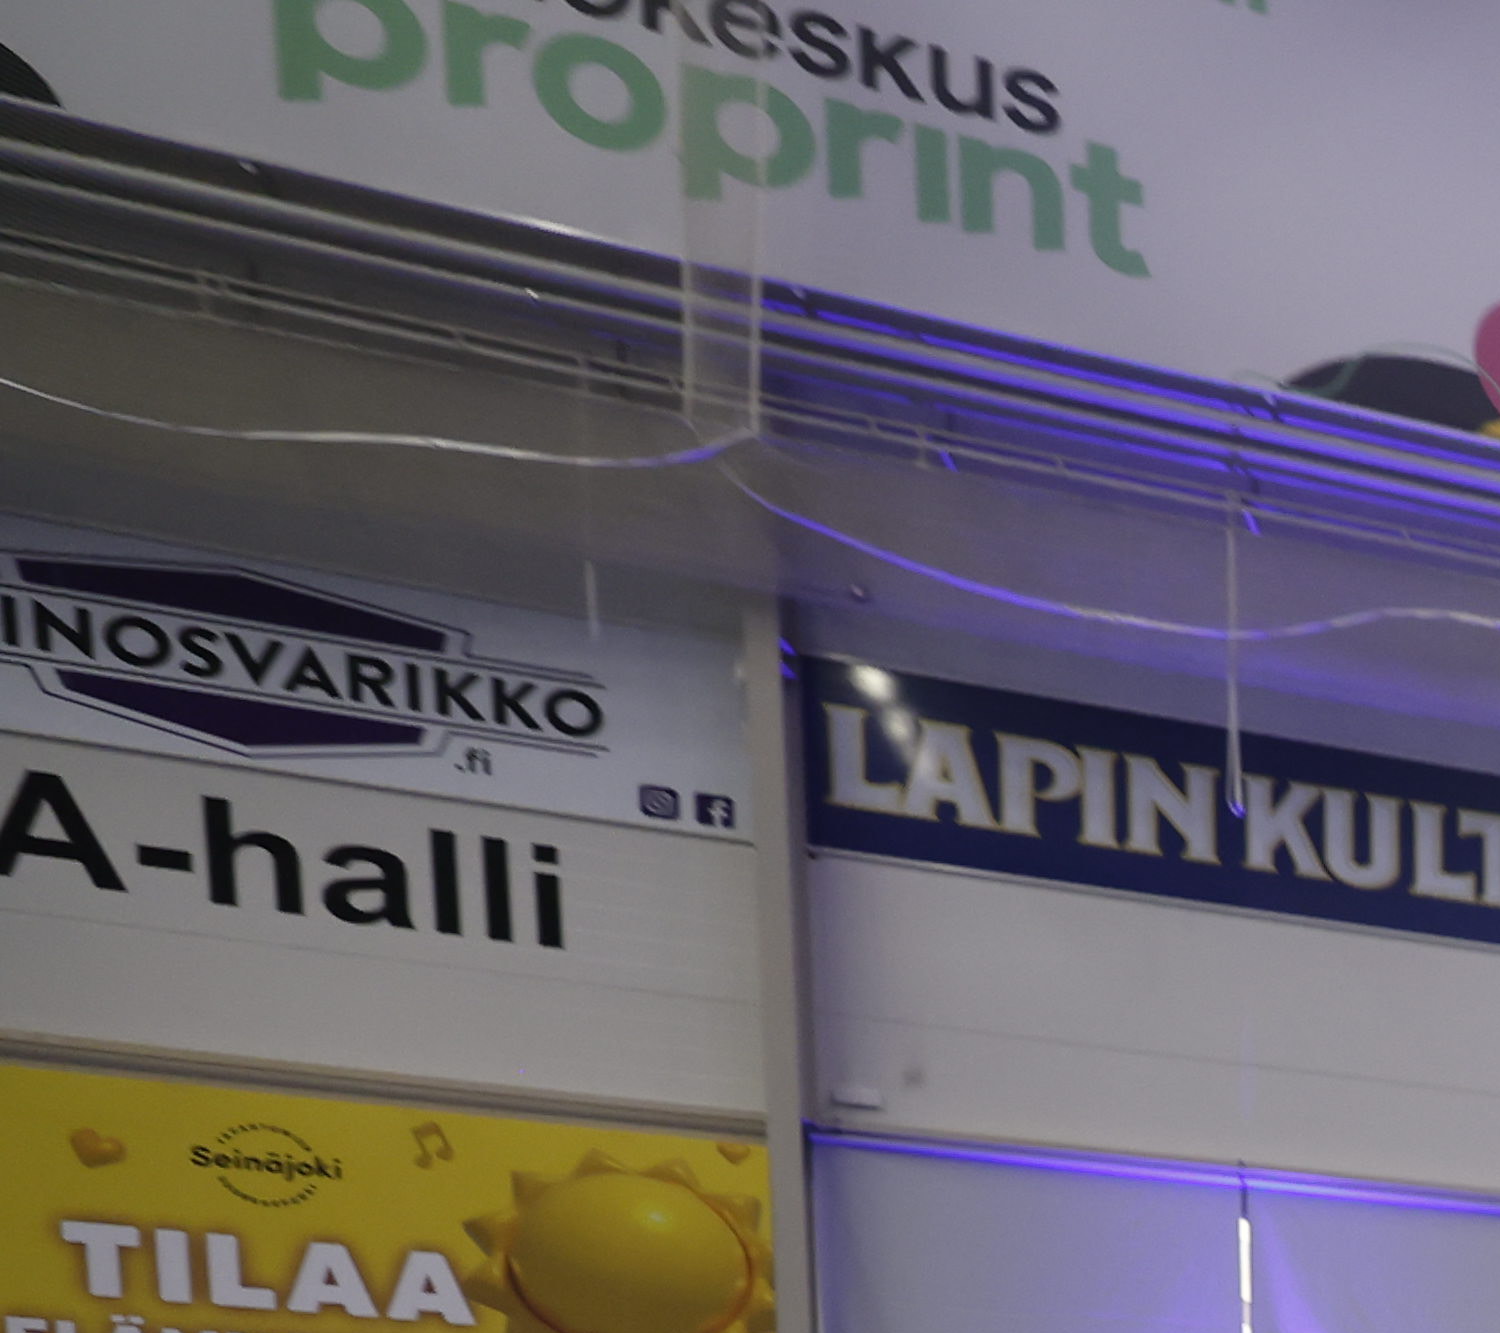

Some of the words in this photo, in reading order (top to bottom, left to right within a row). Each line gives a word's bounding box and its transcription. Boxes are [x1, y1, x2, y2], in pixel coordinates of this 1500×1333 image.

[562, 0, 1062, 135] keskus
[272, 0, 1151, 279] proprint
[455, 747, 493, 777] .fi
[821, 700, 1221, 866] LAPIN
[0, 769, 566, 949] A-halli
[190, 1144, 343, 1182] Seinäjoki
[60, 1219, 476, 1327] TILAA
